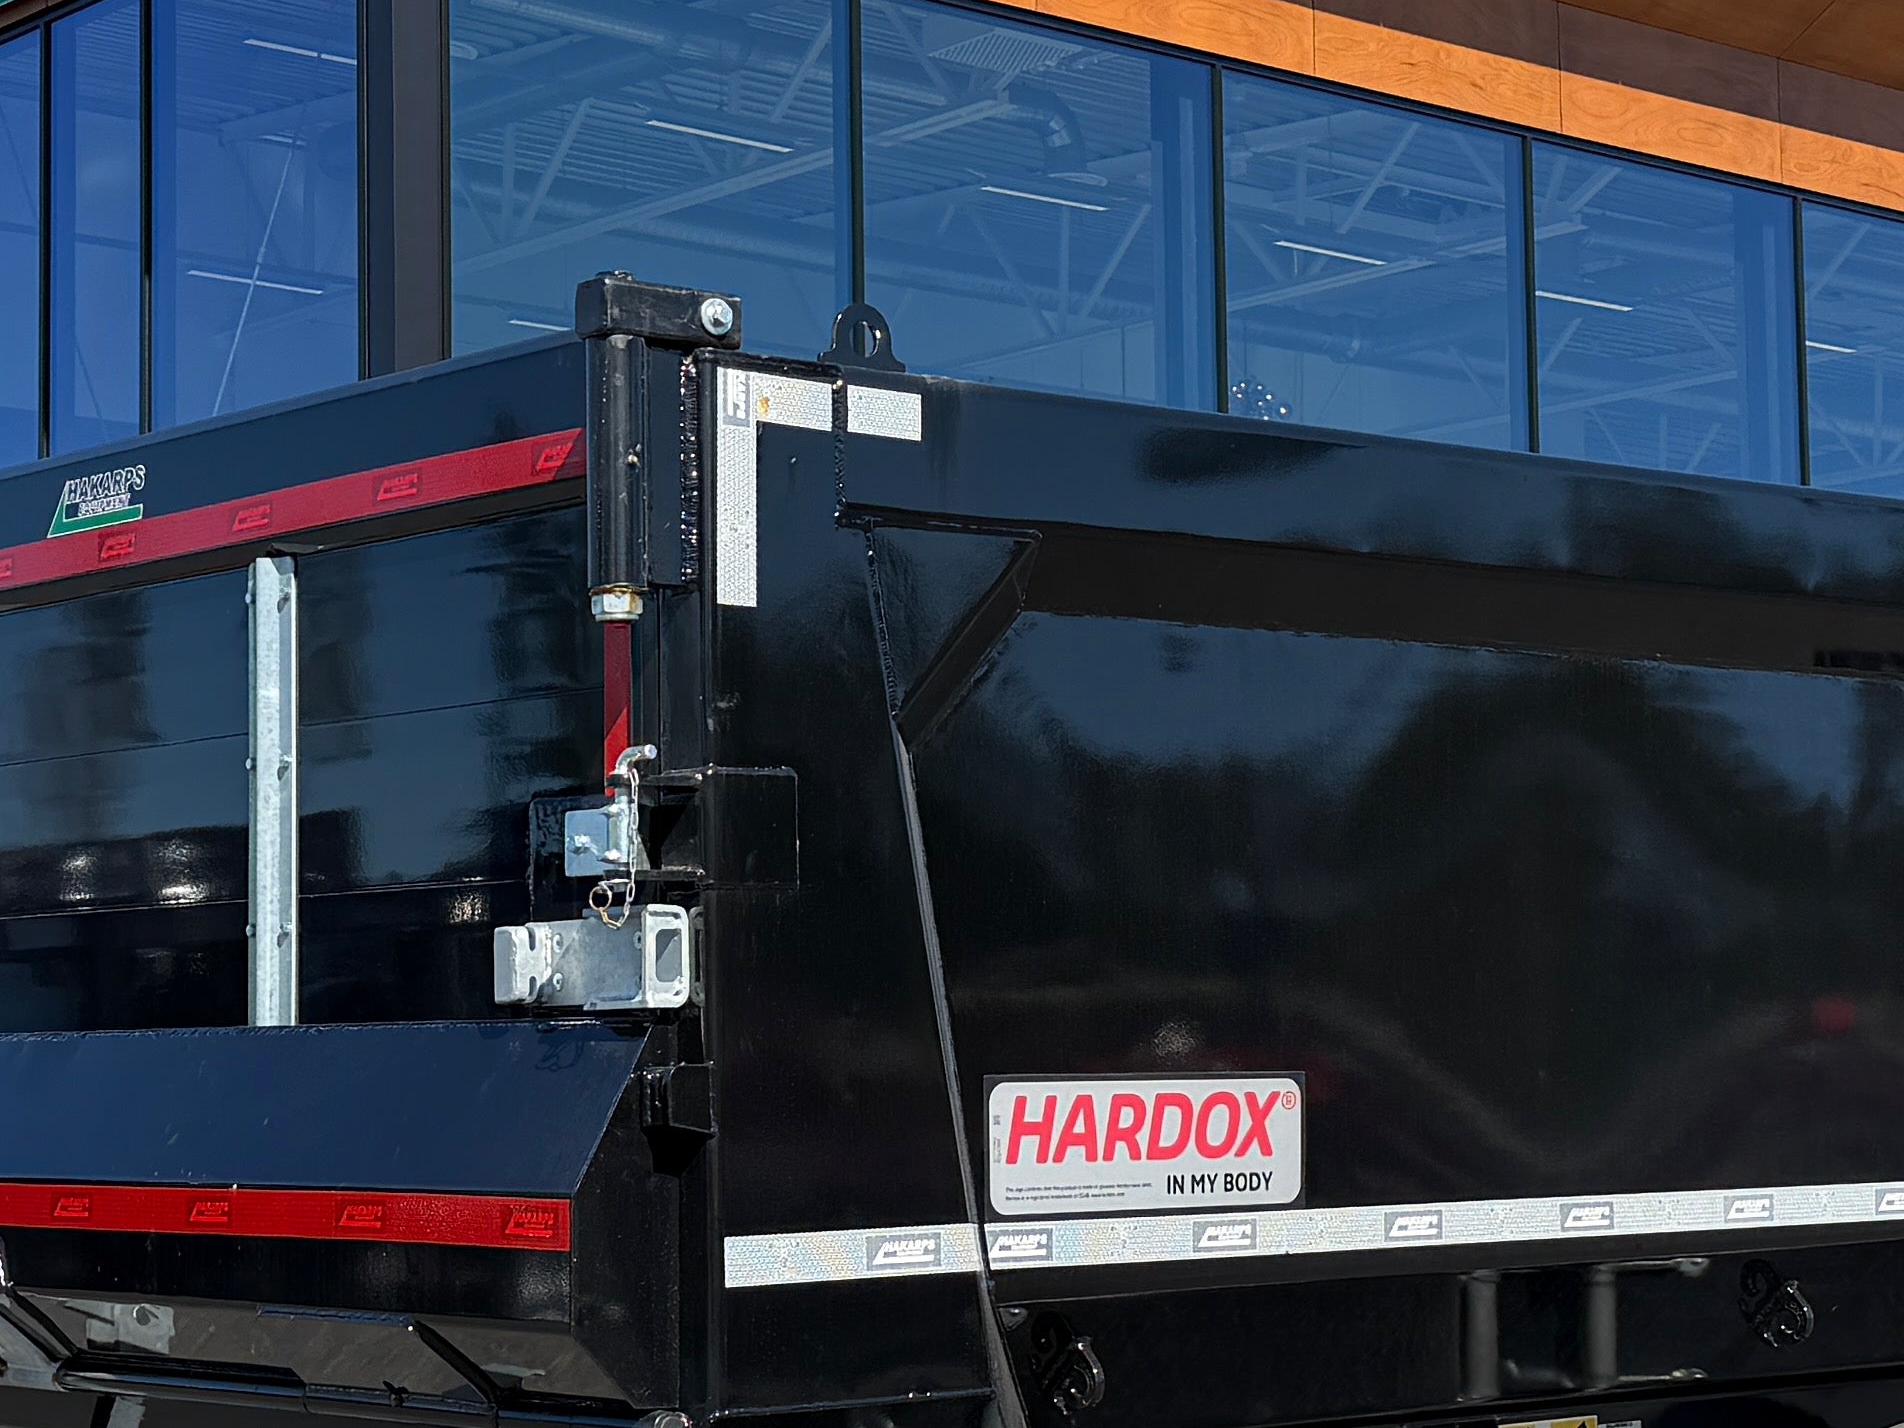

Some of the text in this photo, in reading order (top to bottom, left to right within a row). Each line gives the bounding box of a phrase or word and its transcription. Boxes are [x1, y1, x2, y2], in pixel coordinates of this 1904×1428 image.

[66, 464, 146, 503] HAKARPS
[1166, 1174, 1184, 1195] IN
[1191, 1173, 1219, 1194] MY
[1223, 1170, 1274, 1193] BODY
